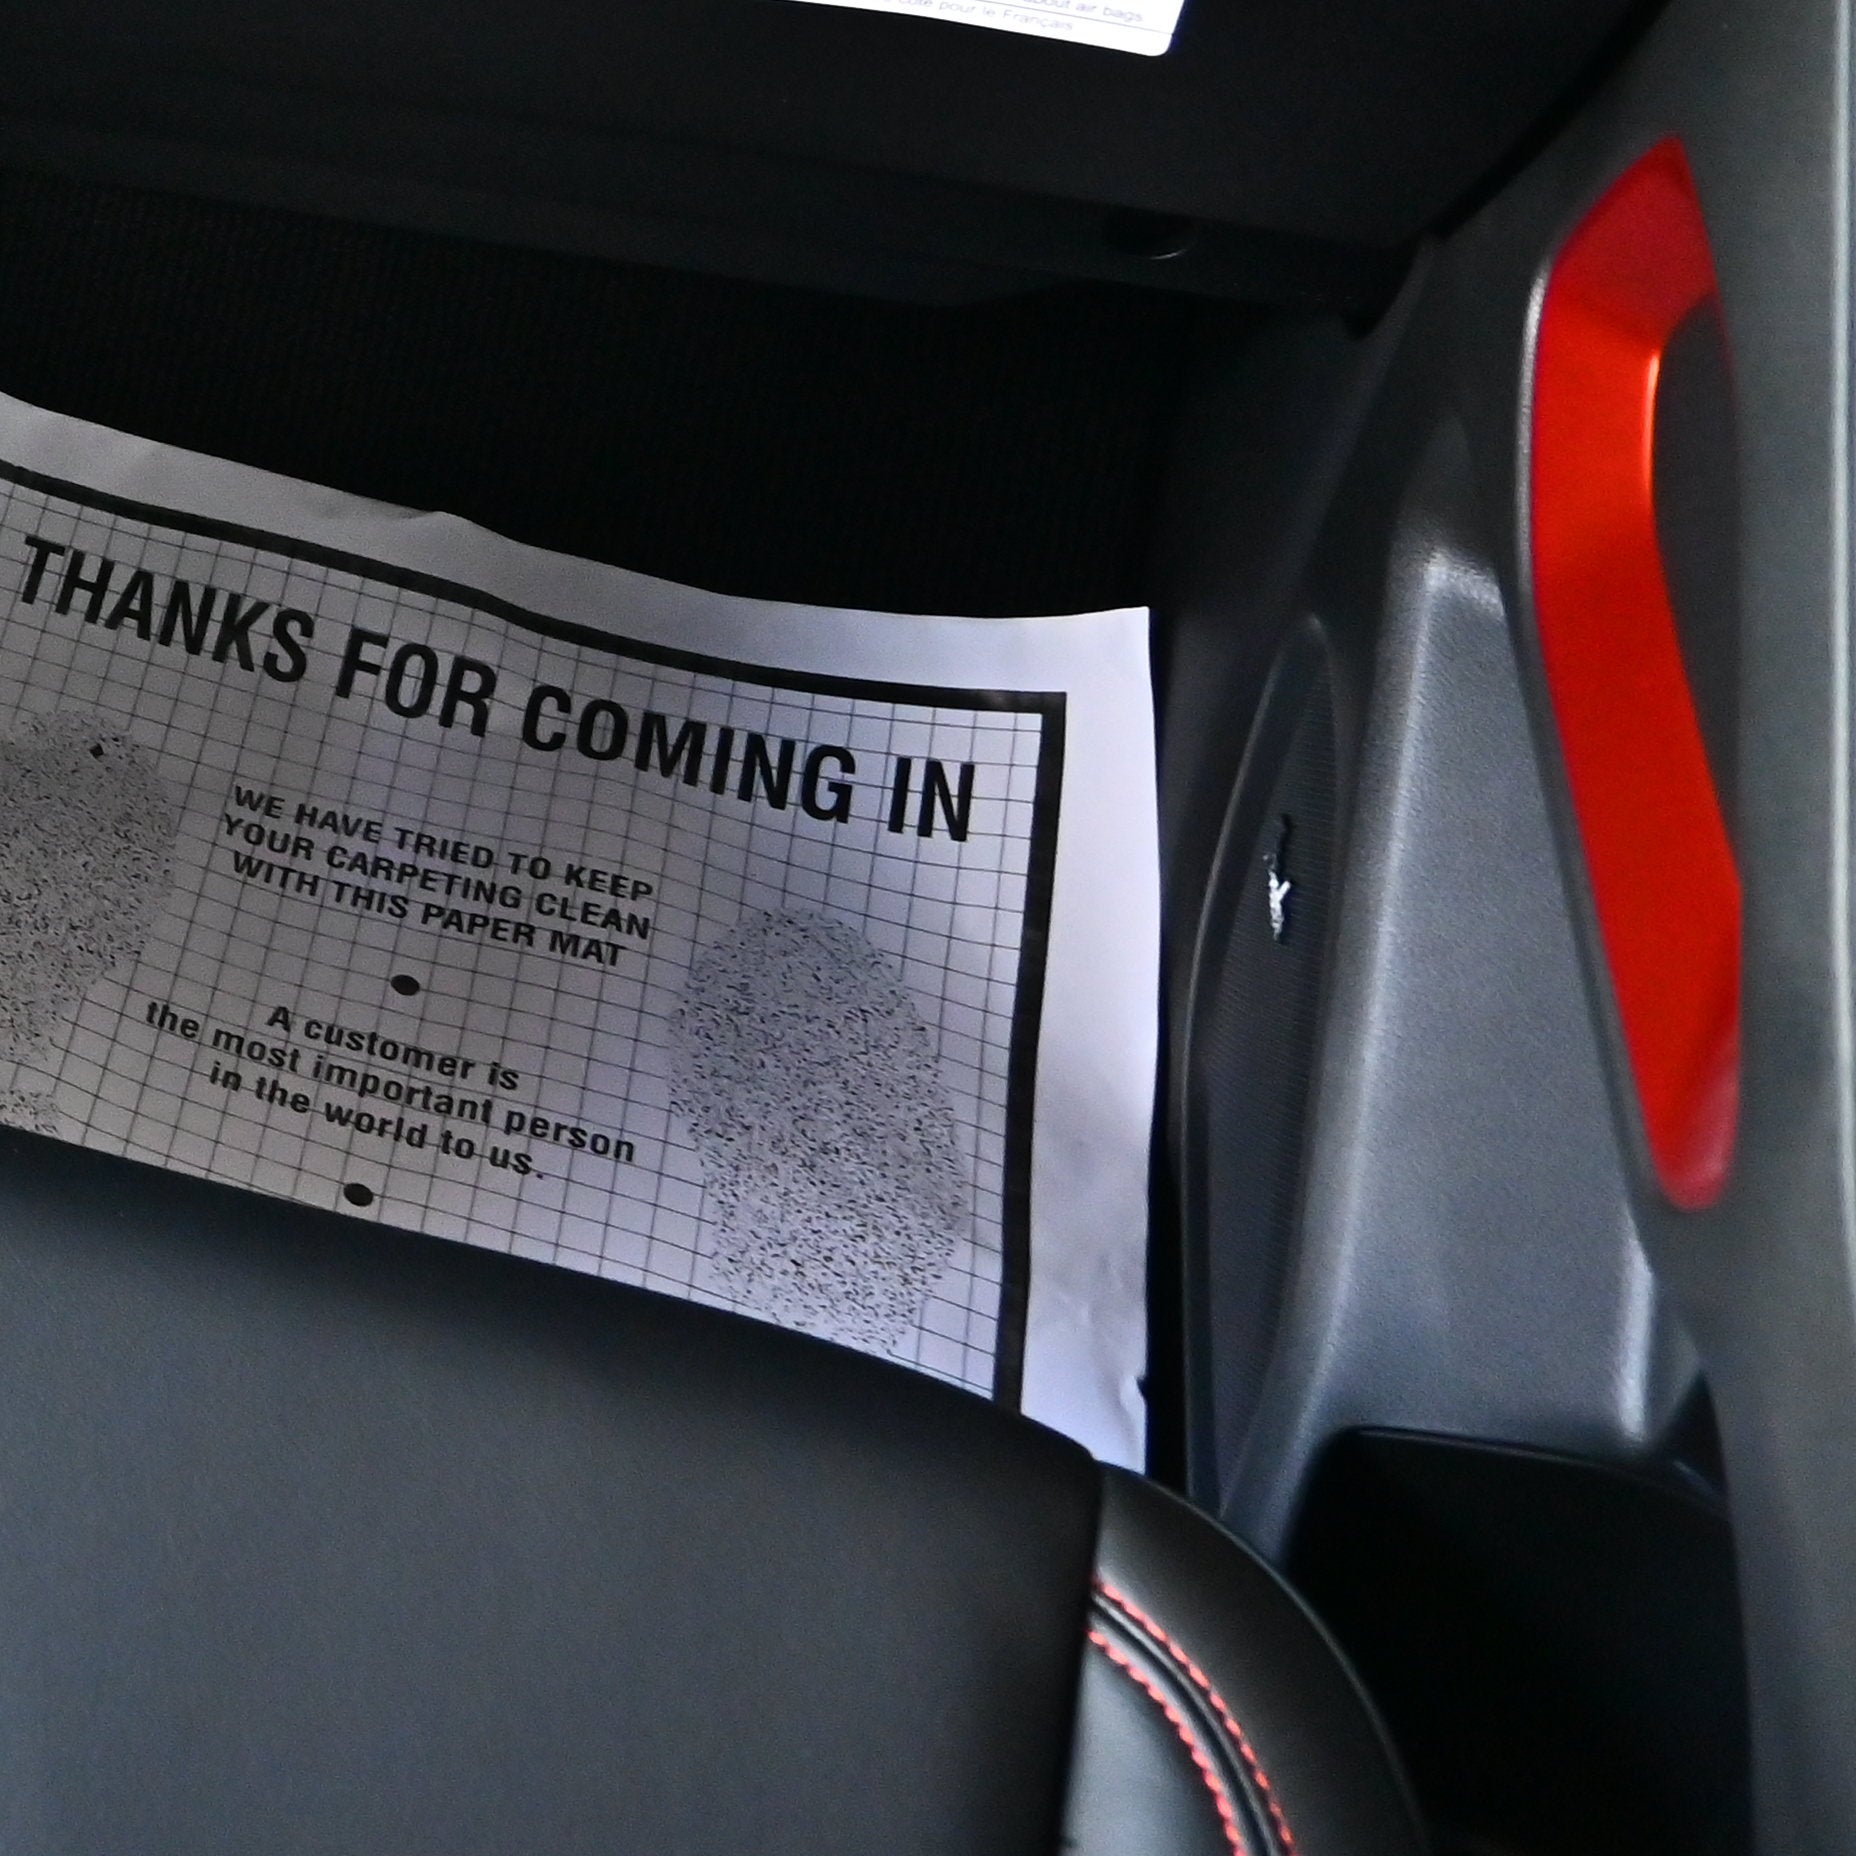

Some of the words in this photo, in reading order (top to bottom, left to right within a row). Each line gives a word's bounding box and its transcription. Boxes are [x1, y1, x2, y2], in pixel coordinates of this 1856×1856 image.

[17, 534, 316, 685] THANKS
[334, 625, 498, 739] FOR
[521, 683, 857, 826] COMING
[887, 755, 976, 843] IN
[223, 813, 316, 863] YOUR
[326, 843, 522, 910] CARPETING
[534, 892, 651, 940] CLEAN
[233, 784, 286, 820] WE
[293, 802, 384, 843] HAVE
[393, 825, 495, 870] TRIED
[507, 851, 552, 881] TO
[563, 862, 654, 903] KEEP
[232, 850, 321, 897] WITH
[333, 879, 410, 919] THIS
[421, 903, 536, 948] PAPER
[548, 929, 627, 968] MAT
[145, 1000, 200, 1040] the
[212, 1029, 303, 1074] most
[311, 1053, 493, 1124] important
[503, 1108, 636, 1163] person
[266, 1005, 292, 1032] A
[303, 1016, 477, 1081] customer
[487, 1061, 521, 1091] is
[208, 1060, 243, 1091] in
[254, 1075, 311, 1114] the
[324, 1100, 430, 1150] world
[440, 1128, 476, 1160] to
[488, 1146, 546, 1181] us.
